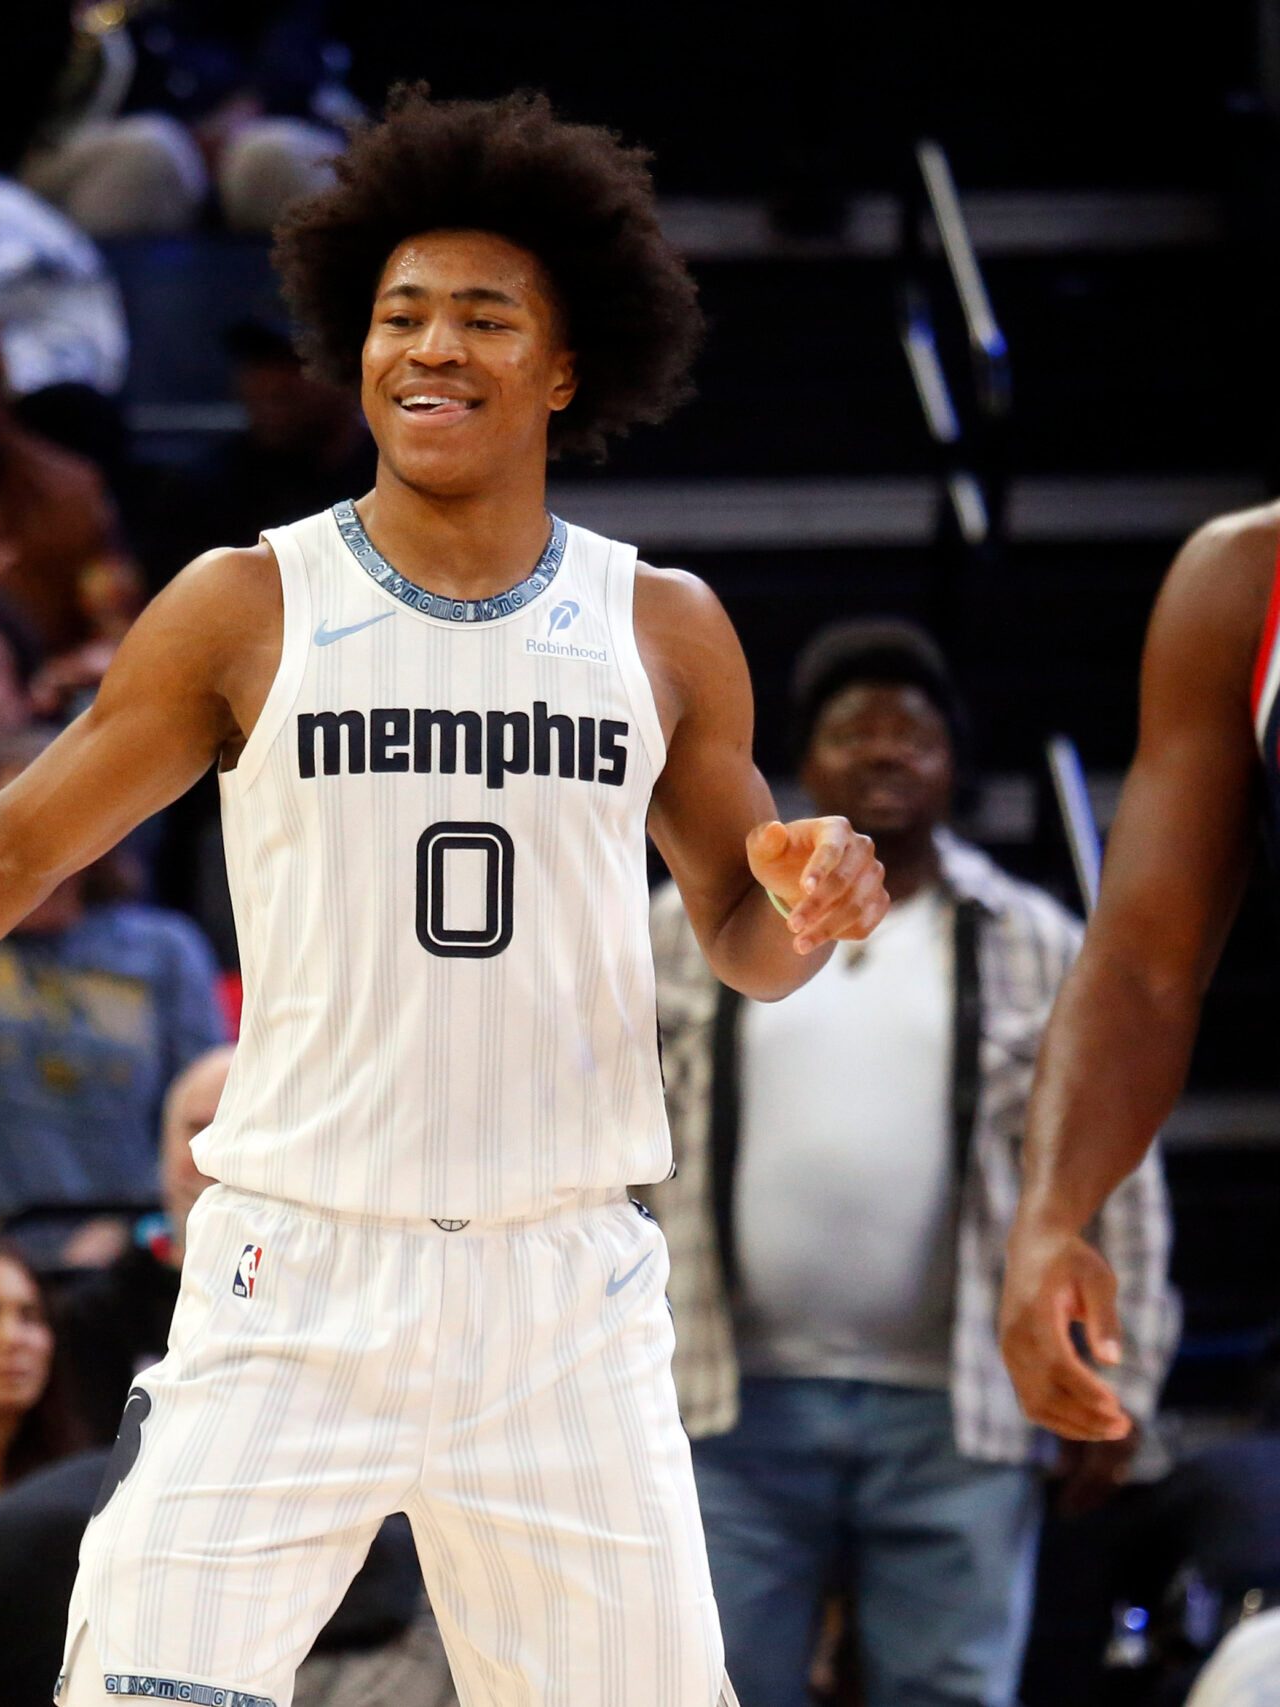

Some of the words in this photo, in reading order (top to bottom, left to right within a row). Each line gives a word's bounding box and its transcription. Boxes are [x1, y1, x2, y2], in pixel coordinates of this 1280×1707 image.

[526, 638, 608, 662] Robinhood
[297, 700, 629, 790] memphis
[415, 821, 515, 959] 0
